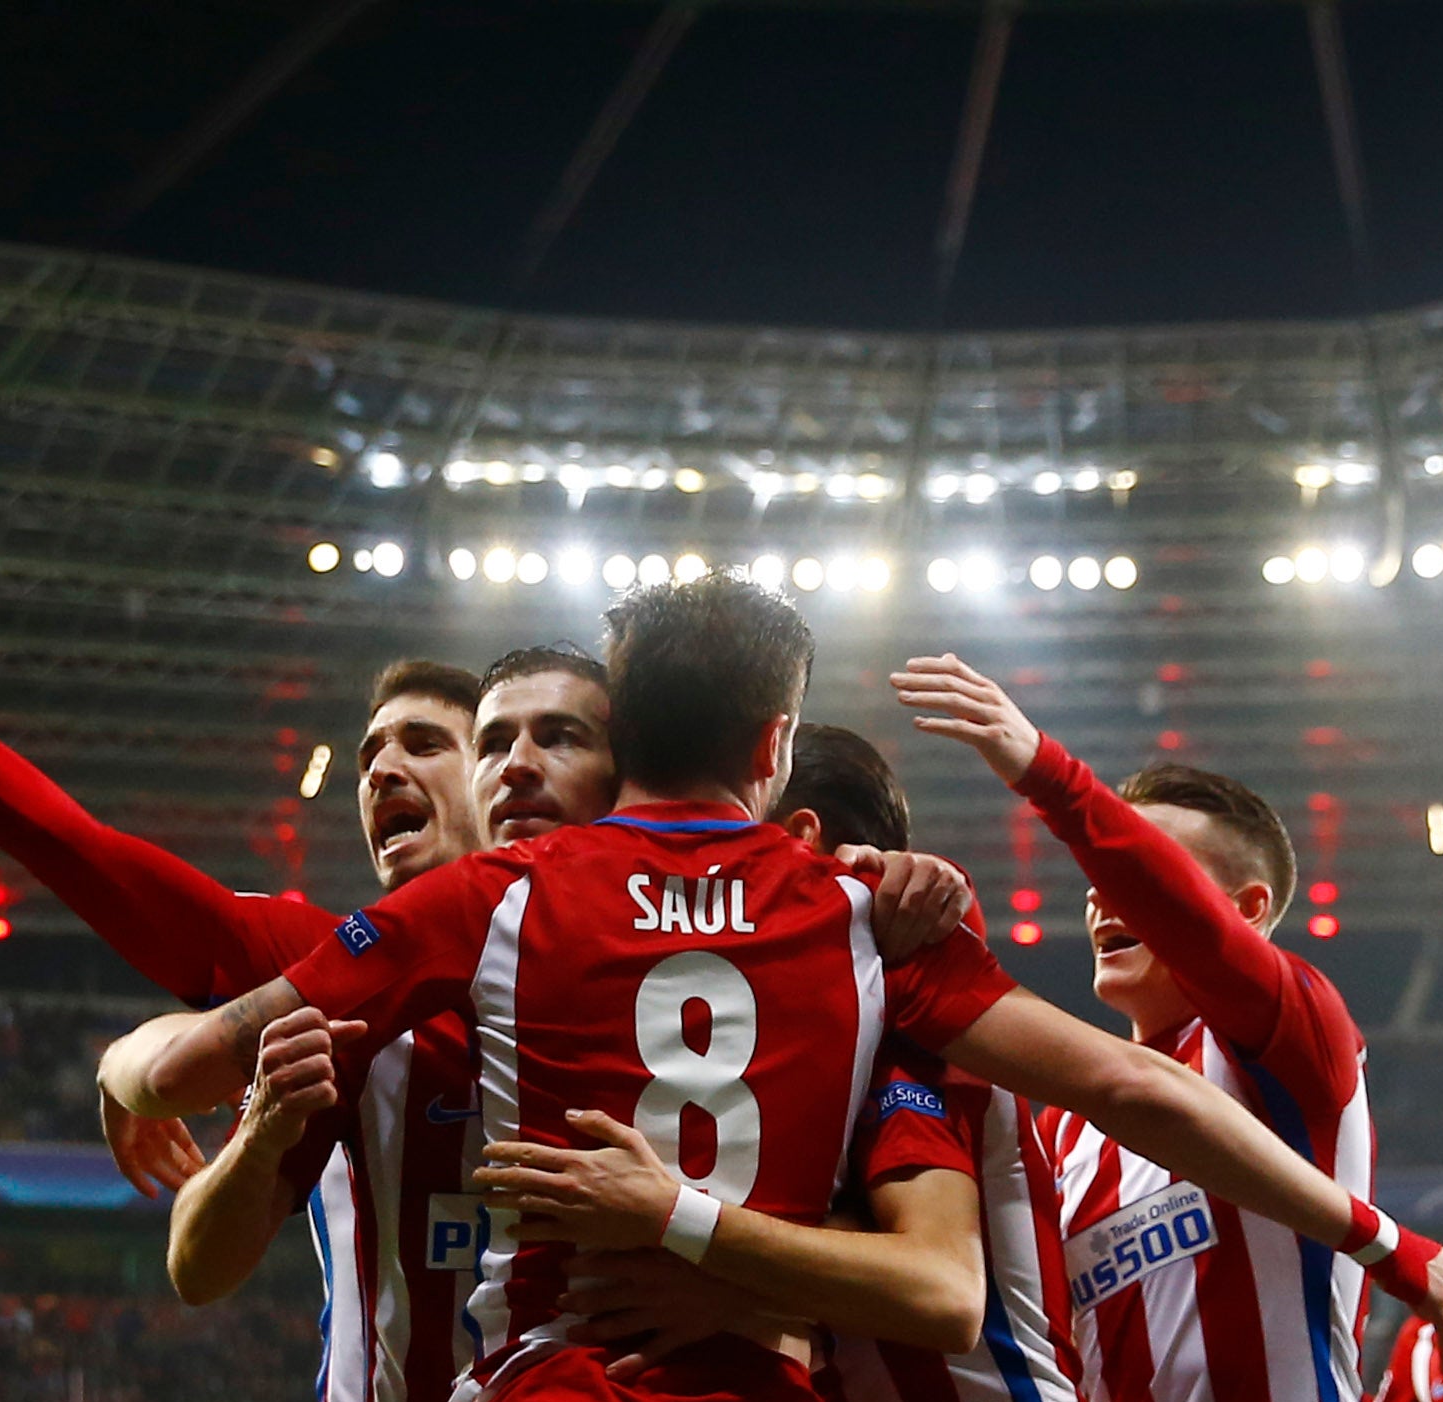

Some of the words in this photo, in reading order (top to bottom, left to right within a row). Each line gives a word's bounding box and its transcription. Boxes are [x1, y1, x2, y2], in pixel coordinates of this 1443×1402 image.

[627, 864, 756, 934] SAÚL
[633, 949, 761, 1207] 8
[1110, 1213, 1147, 1240] Trade
[1149, 1191, 1199, 1220] Online
